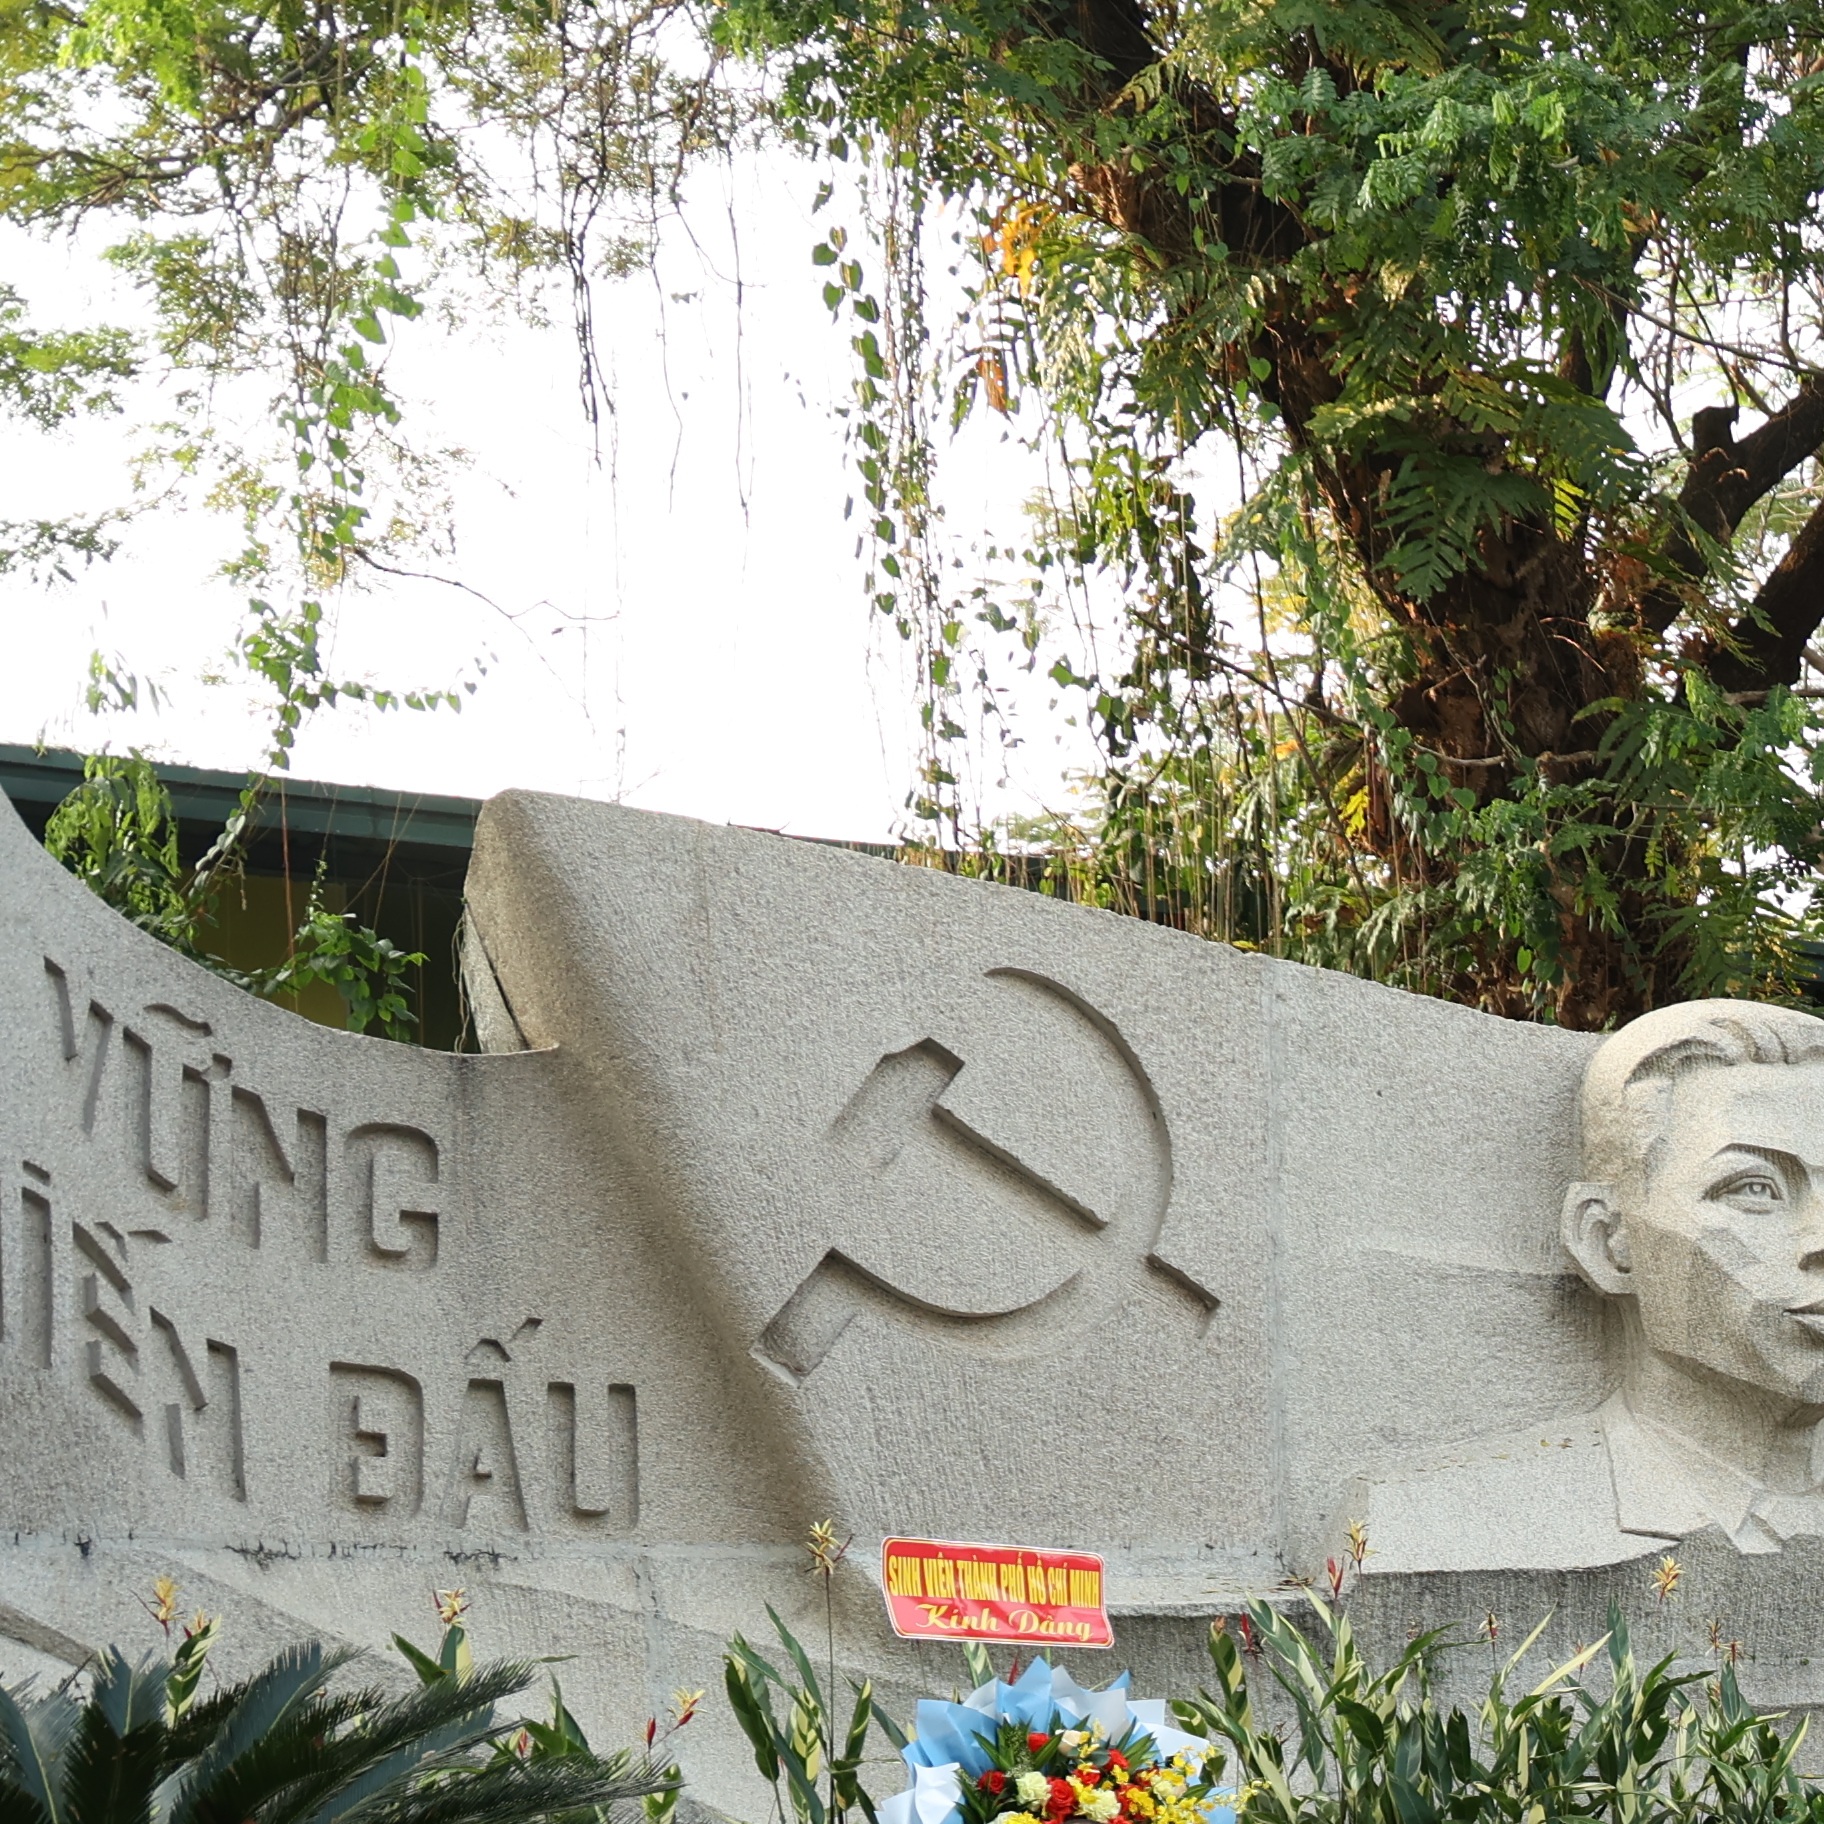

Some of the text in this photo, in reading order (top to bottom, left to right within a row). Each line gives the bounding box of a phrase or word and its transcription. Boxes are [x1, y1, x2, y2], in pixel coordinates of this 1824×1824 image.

[43, 955, 440, 1268] VỮNG
[327, 1317, 639, 1531] ĐẤU
[888, 1551, 1100, 1609] SINH VIÊN THÀNH PHỐ HỒ CHÍ MINH
[1008, 1609, 1094, 1642] Dâng
